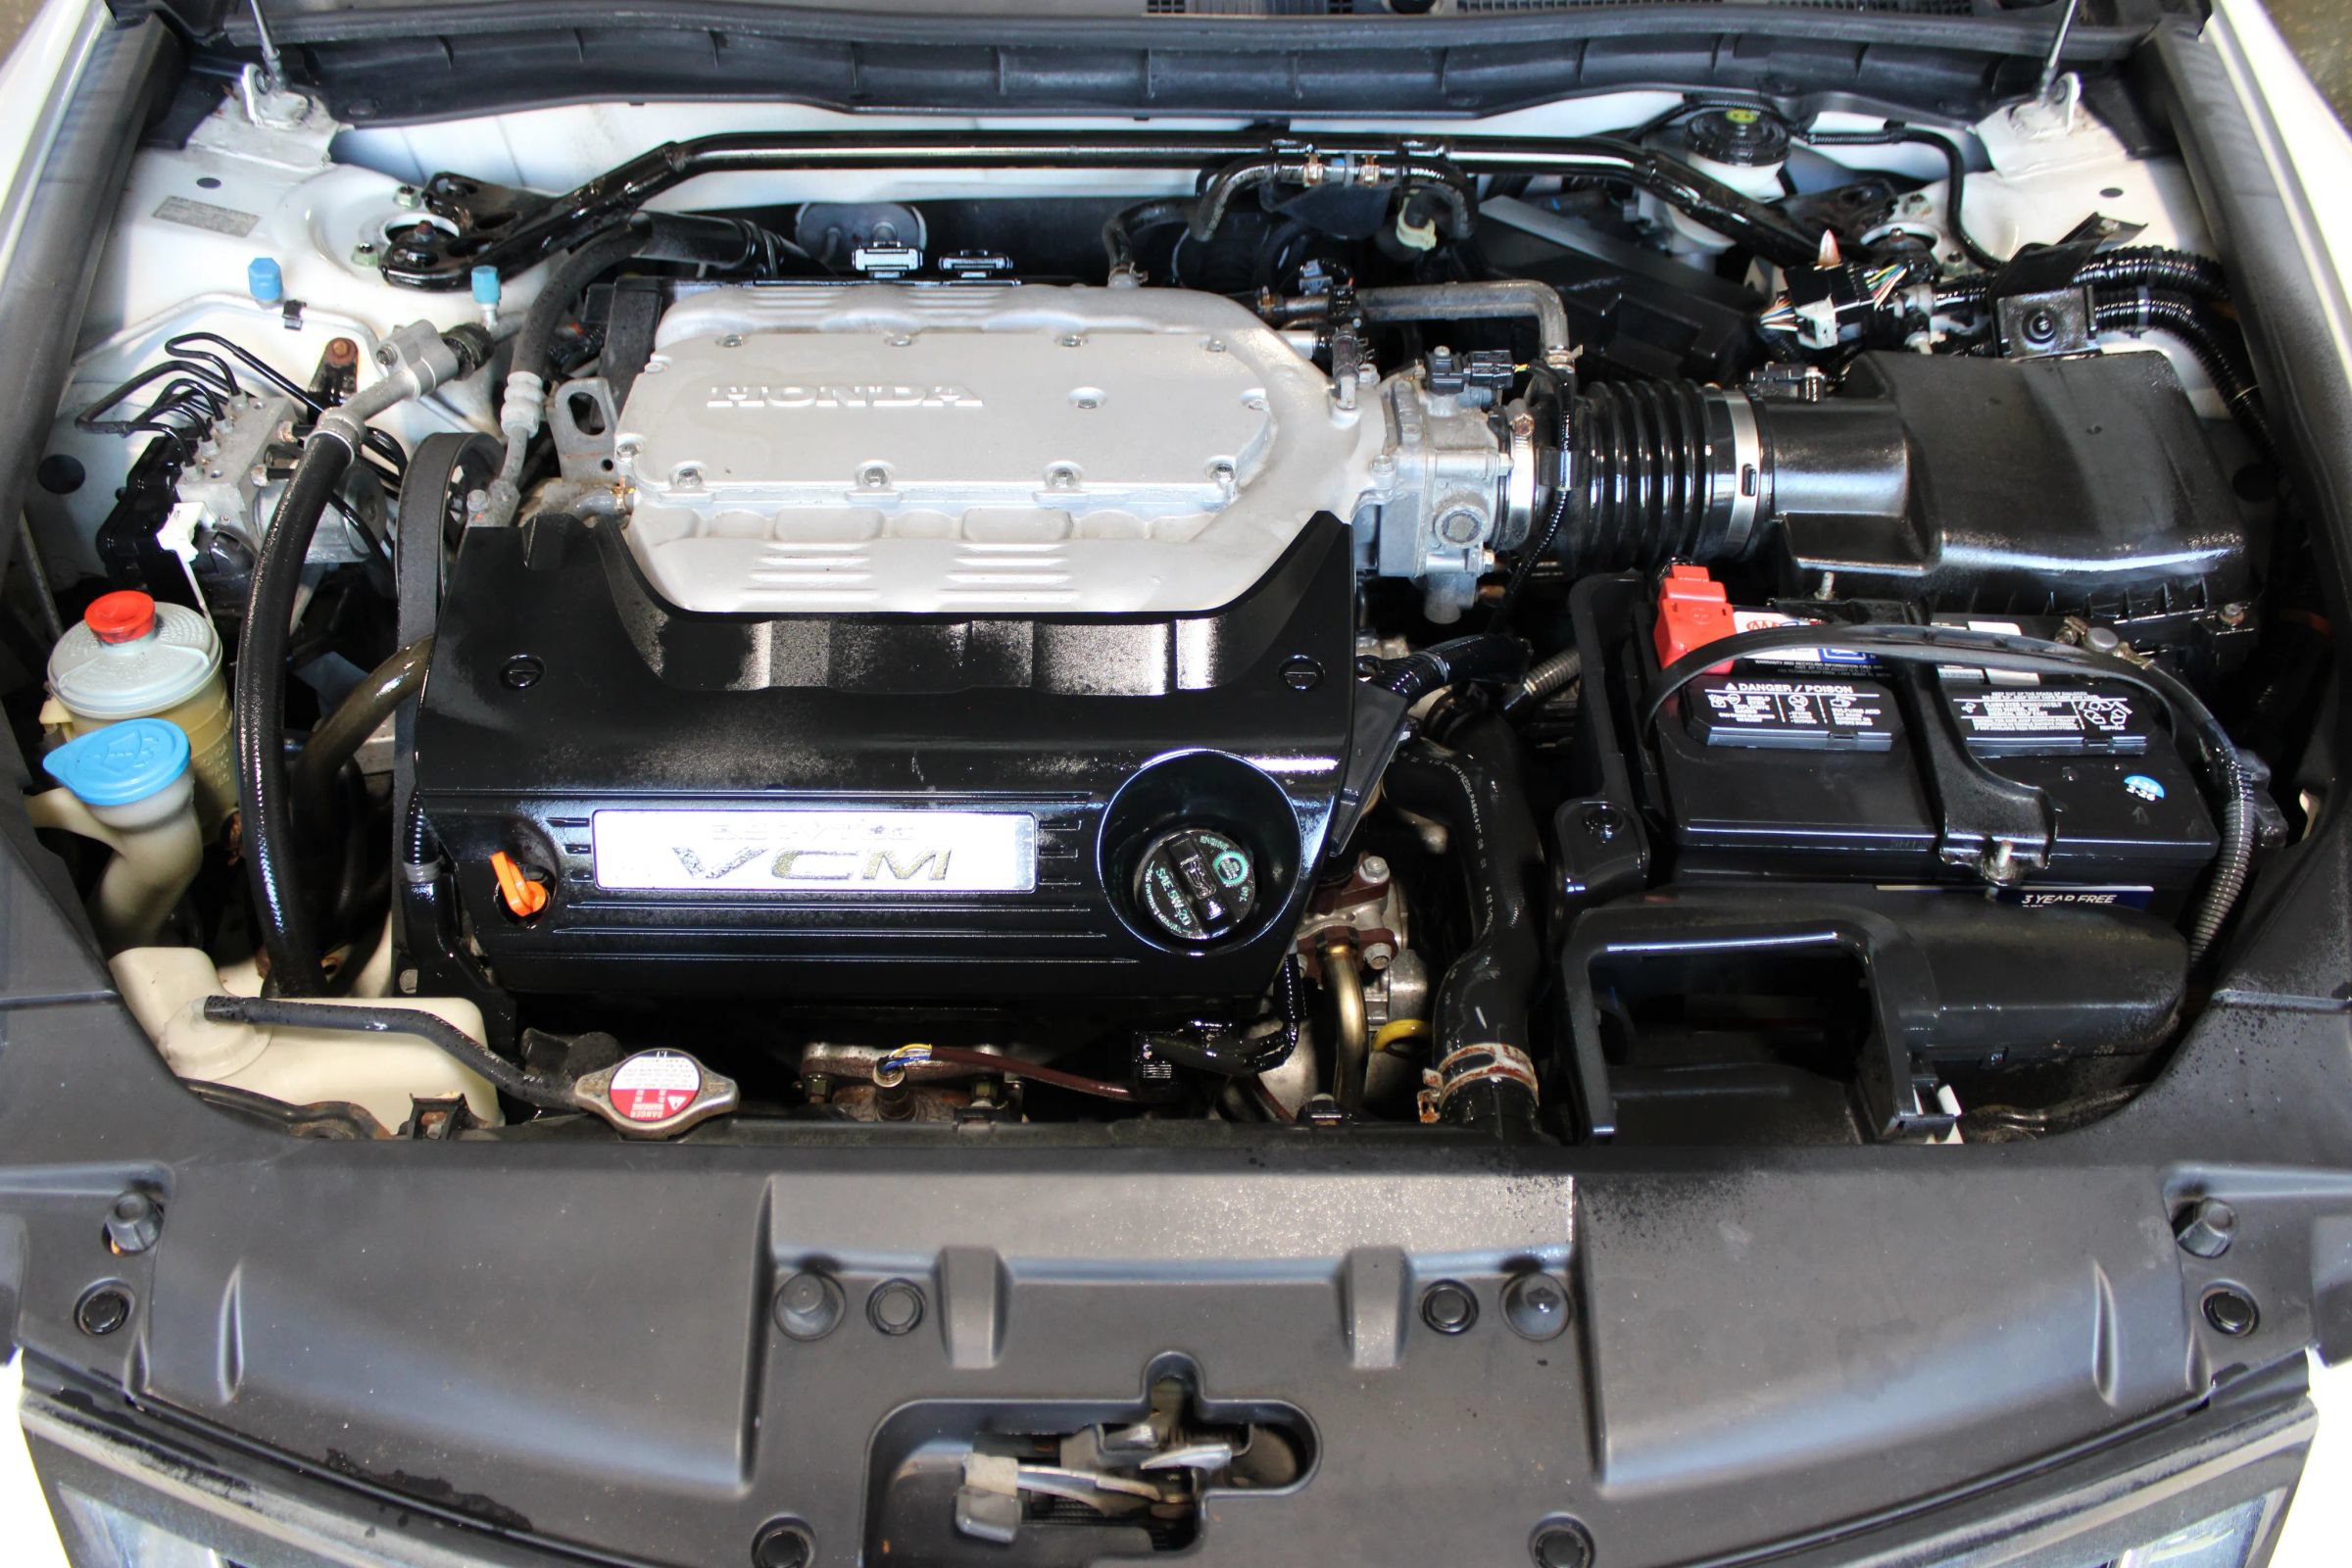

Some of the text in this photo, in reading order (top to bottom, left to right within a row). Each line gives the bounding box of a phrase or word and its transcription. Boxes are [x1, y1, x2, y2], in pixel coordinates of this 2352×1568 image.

[707, 386, 983, 408] HONDA
[1739, 683, 1792, 692] DANGER
[1804, 685, 1853, 694] POISON
[671, 846, 953, 881] VCM
[1155, 867, 1193, 926] SAE 5W-20
[2022, 895, 2033, 904] 3
[2077, 894, 2118, 905] FREE
